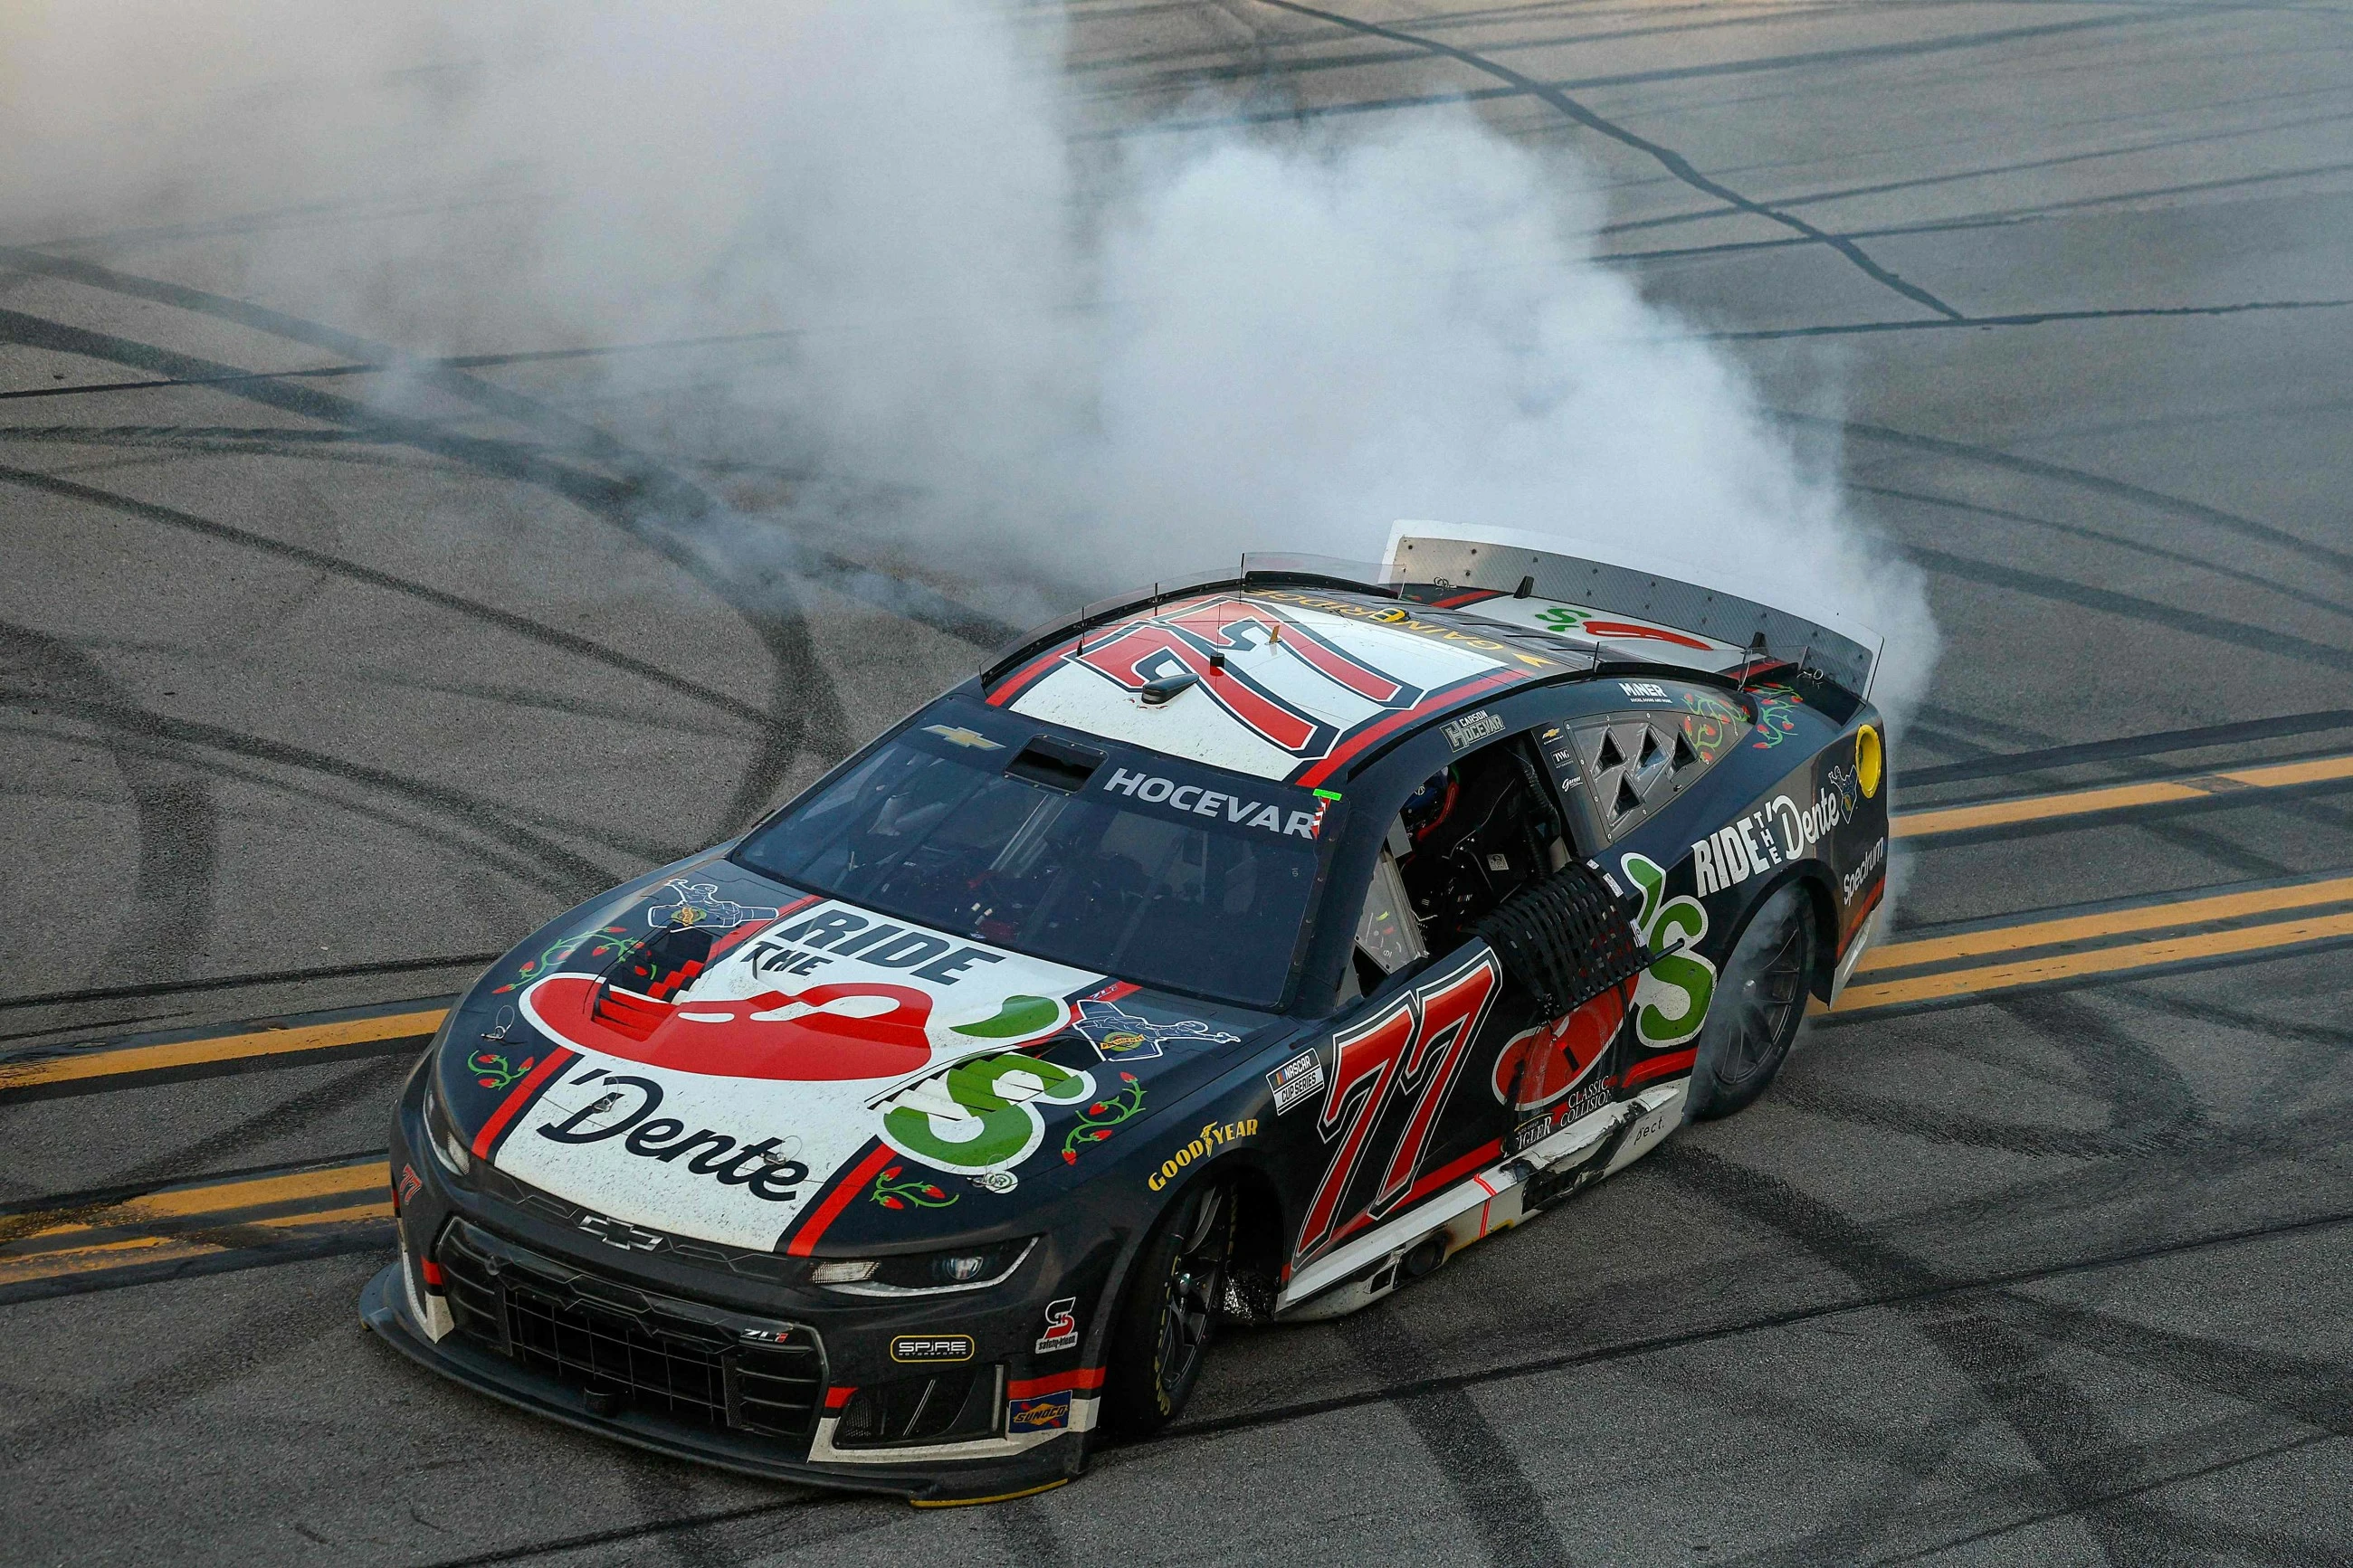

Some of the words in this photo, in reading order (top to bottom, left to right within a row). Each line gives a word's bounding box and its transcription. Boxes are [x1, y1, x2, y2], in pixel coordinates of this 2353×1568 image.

[1247, 587, 1504, 651] GAINRIDGE
[1061, 597, 1427, 758] 77
[1618, 682, 1668, 698] MINER
[1445, 714, 1505, 750] HOCEVAR
[1459, 710, 1489, 727] CARSON
[1553, 749, 1571, 763] TWG
[1103, 767, 1315, 840] HOCEVAR
[1691, 816, 1770, 898] RIDE
[1754, 811, 1783, 865] THE
[1843, 836, 1884, 907] Spectrum
[740, 941, 834, 976] THE
[776, 908, 1006, 986] RIDE
[1284, 1055, 1311, 1079] NASCAR
[1281, 1087, 1294, 1103] CUP
[1294, 1072, 1317, 1095] SERIES
[1567, 1075, 1610, 1108] CLASSIC
[1293, 947, 1501, 1270] 77
[1148, 1118, 1259, 1192] GOODYEAR
[399, 1163, 423, 1205] 77
[740, 1328, 789, 1344] ZL1
[899, 1340, 967, 1353] SPIRE
[1015, 1405, 1068, 1423] SUNOCO
